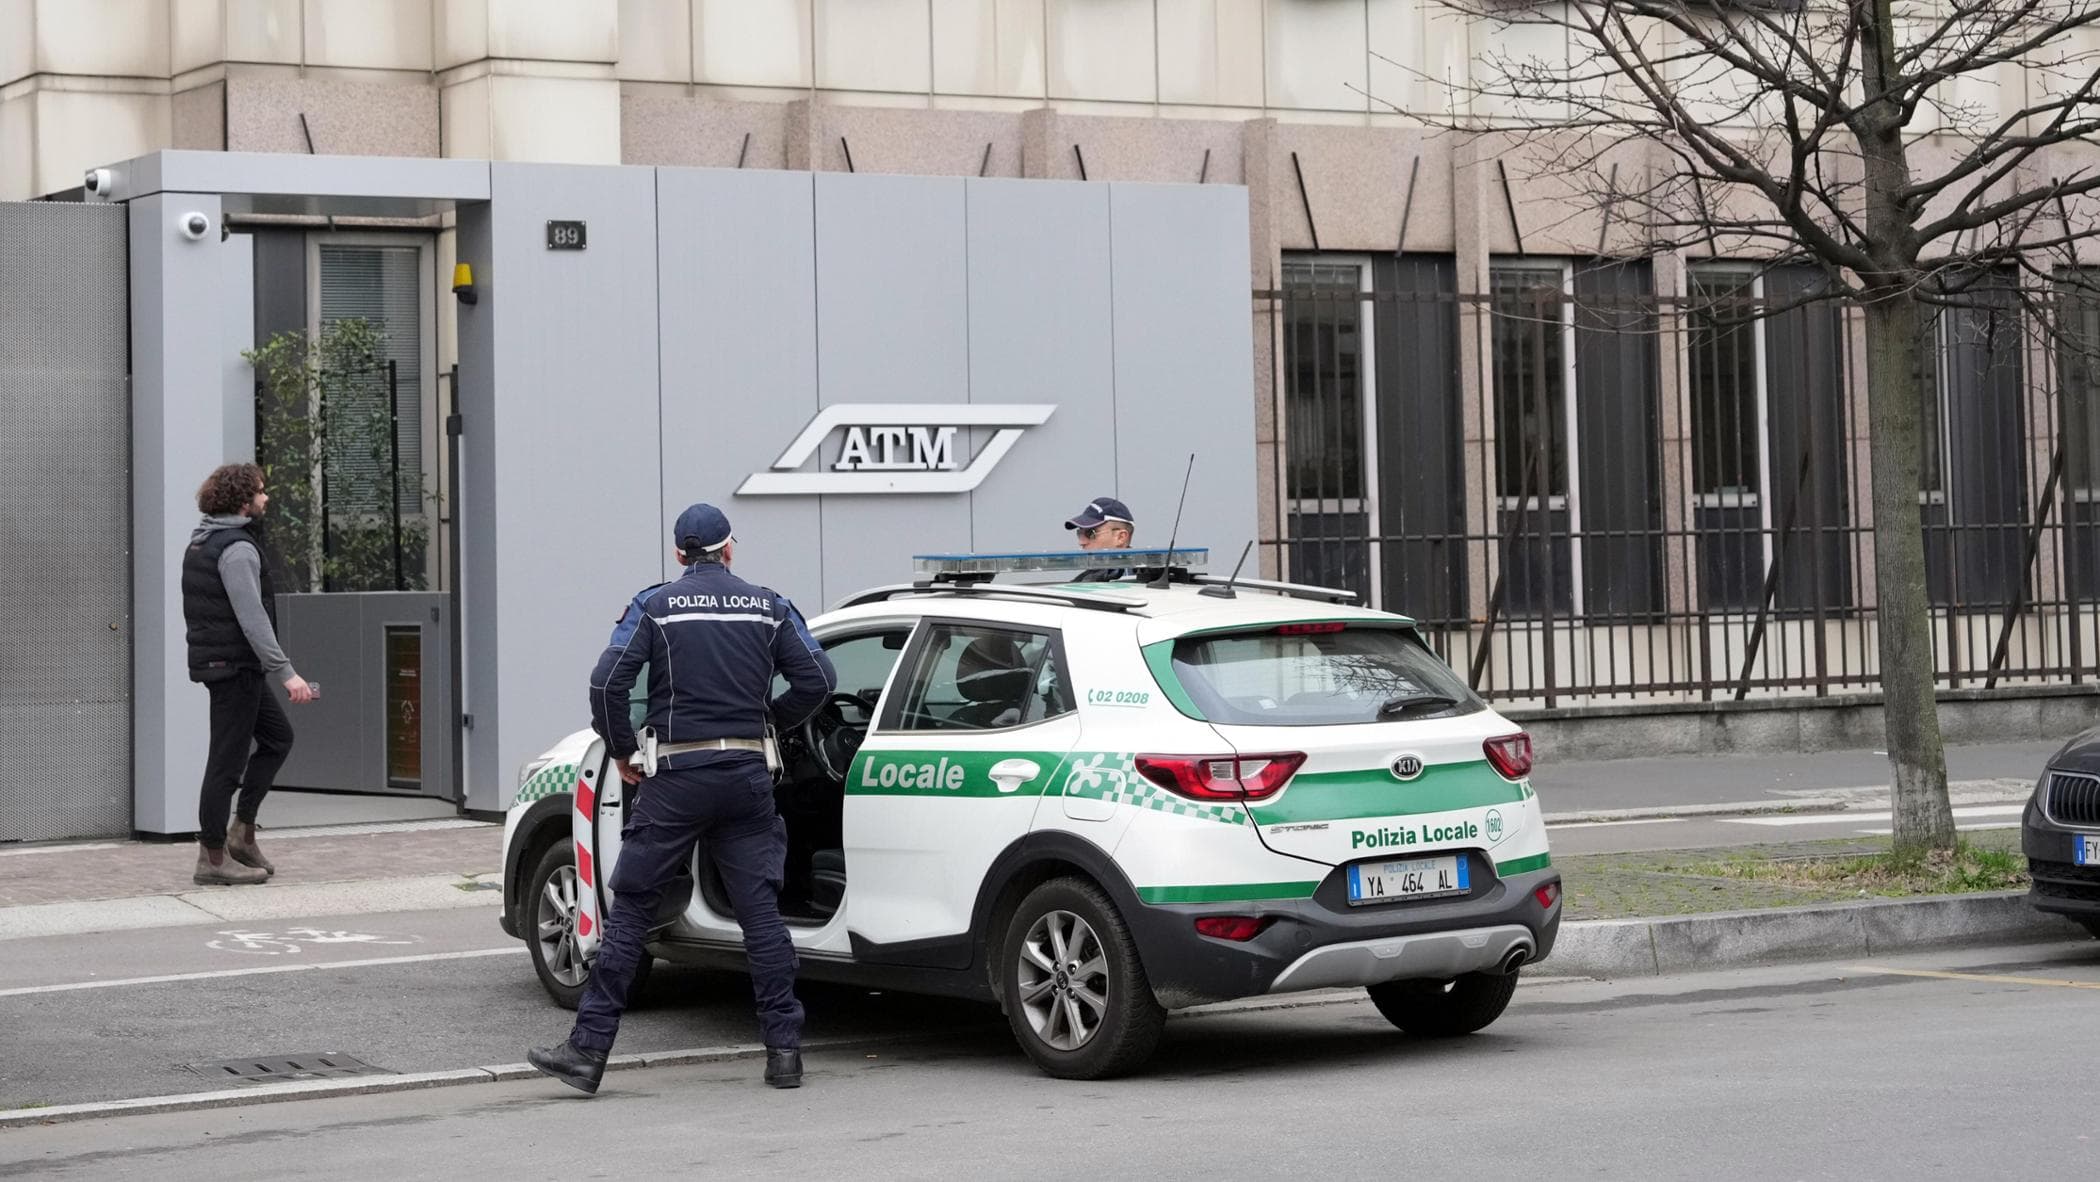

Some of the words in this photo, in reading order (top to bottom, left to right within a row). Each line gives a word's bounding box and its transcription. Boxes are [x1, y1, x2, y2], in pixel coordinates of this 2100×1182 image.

[555, 227, 579, 244] 89
[834, 427, 957, 470] ATM
[668, 595, 719, 609] POLIZIA
[723, 596, 771, 610] LOCALE
[1096, 690, 1113, 703] 02
[1116, 691, 1149, 705] 0208
[861, 755, 965, 790] Locale
[1398, 760, 1419, 773] KIA
[1486, 817, 1502, 833] 1602
[1352, 826, 1417, 849] Polizia
[1423, 821, 1478, 843] Locale
[2085, 841, 2099, 860] FY
[1383, 863, 1409, 874] POLIZIA
[1412, 860, 1436, 871] LOCALE
[1367, 876, 1385, 897] YA
[1401, 872, 1425, 892] 464
[1438, 869, 1453, 890] AL
